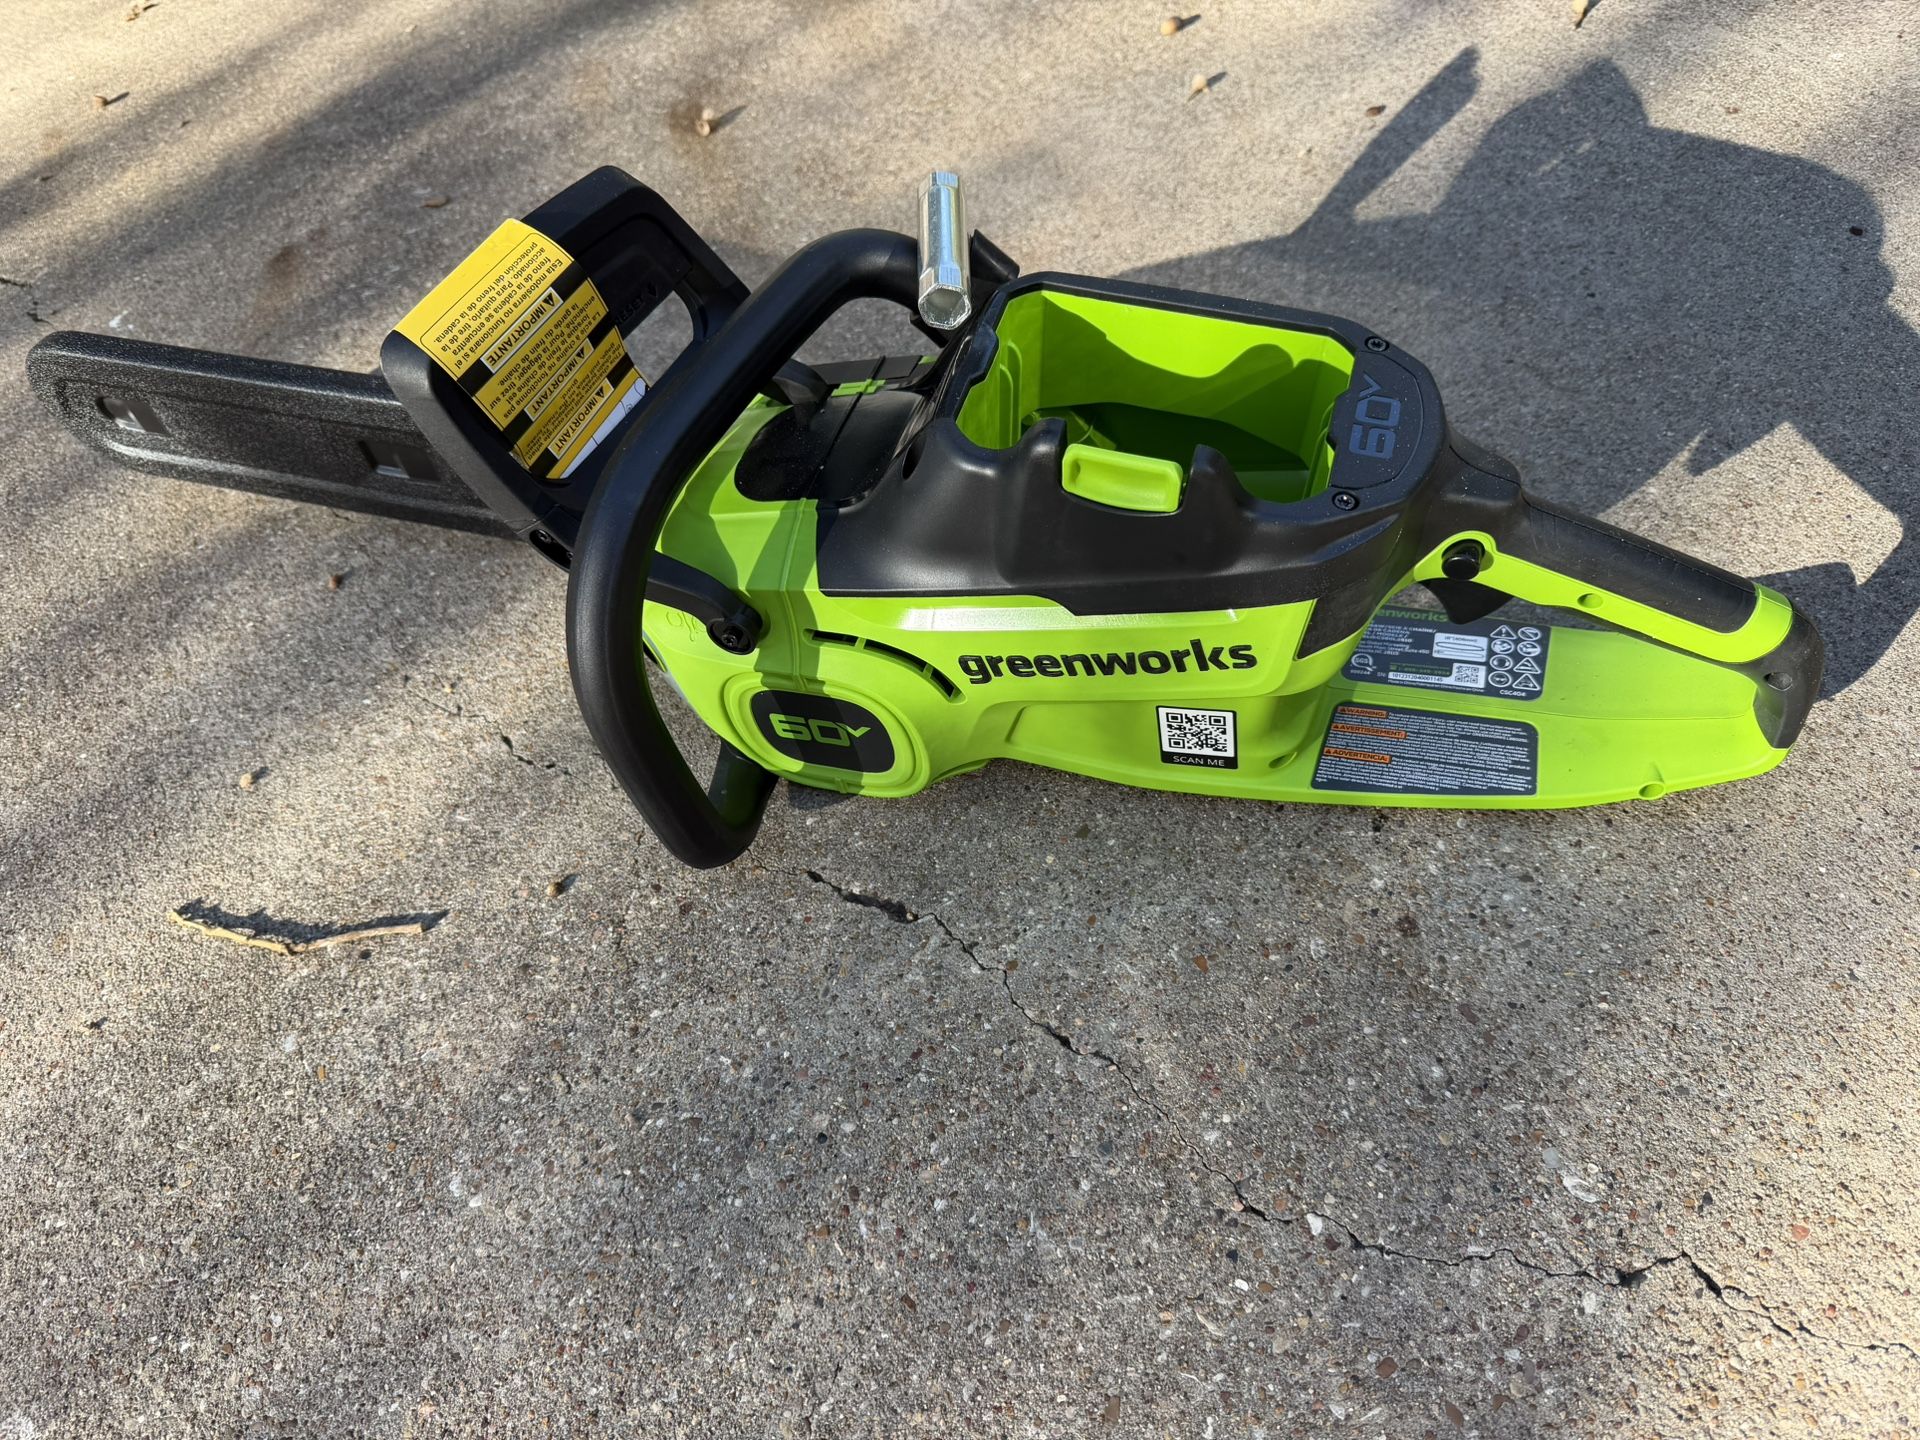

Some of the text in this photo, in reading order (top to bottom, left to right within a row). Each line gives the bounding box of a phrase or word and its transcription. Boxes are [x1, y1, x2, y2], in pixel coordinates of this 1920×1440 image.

[433, 241, 538, 343] protección del freno de la cadena.
[440, 246, 545, 352] accionado. Para quitarlo, tire de la
[451, 255, 551, 356] freno de la cadena se encuentra
[453, 258, 563, 369] Esta motosierra no funcionará si el
[570, 302, 579, 311] la
[553, 308, 571, 329] garde
[591, 310, 601, 321] La
[543, 328, 554, 339] du
[566, 313, 590, 338] lorsque
[579, 319, 592, 335] scie
[486, 303, 546, 366] IMPORTANTE
[548, 329, 565, 347] Pour
[559, 337, 568, 346] le
[528, 337, 546, 355] frein
[541, 345, 550, 354] la
[545, 344, 561, 361] frein
[520, 353, 532, 364] de
[537, 360, 546, 370] de
[546, 360, 556, 371] ne
[499, 380, 516, 397] tirez
[514, 370, 548, 406] fonctionne
[531, 357, 578, 413] IMPORTANT
[489, 395, 501, 410] sur
[505, 391, 517, 405] est
[503, 403, 516, 419] pas
[1349, 371, 1401, 460] 60V
[554, 396, 598, 452] IMPORTANT
[1375, 609, 1448, 622] enworks
[958, 638, 1258, 685] greenworks
[1346, 707, 1386, 717] WARNING:
[769, 713, 871, 747] 60V
[1173, 755, 1225, 767] SCAN ME
[1332, 749, 1388, 762] ADVERTENCIA:
